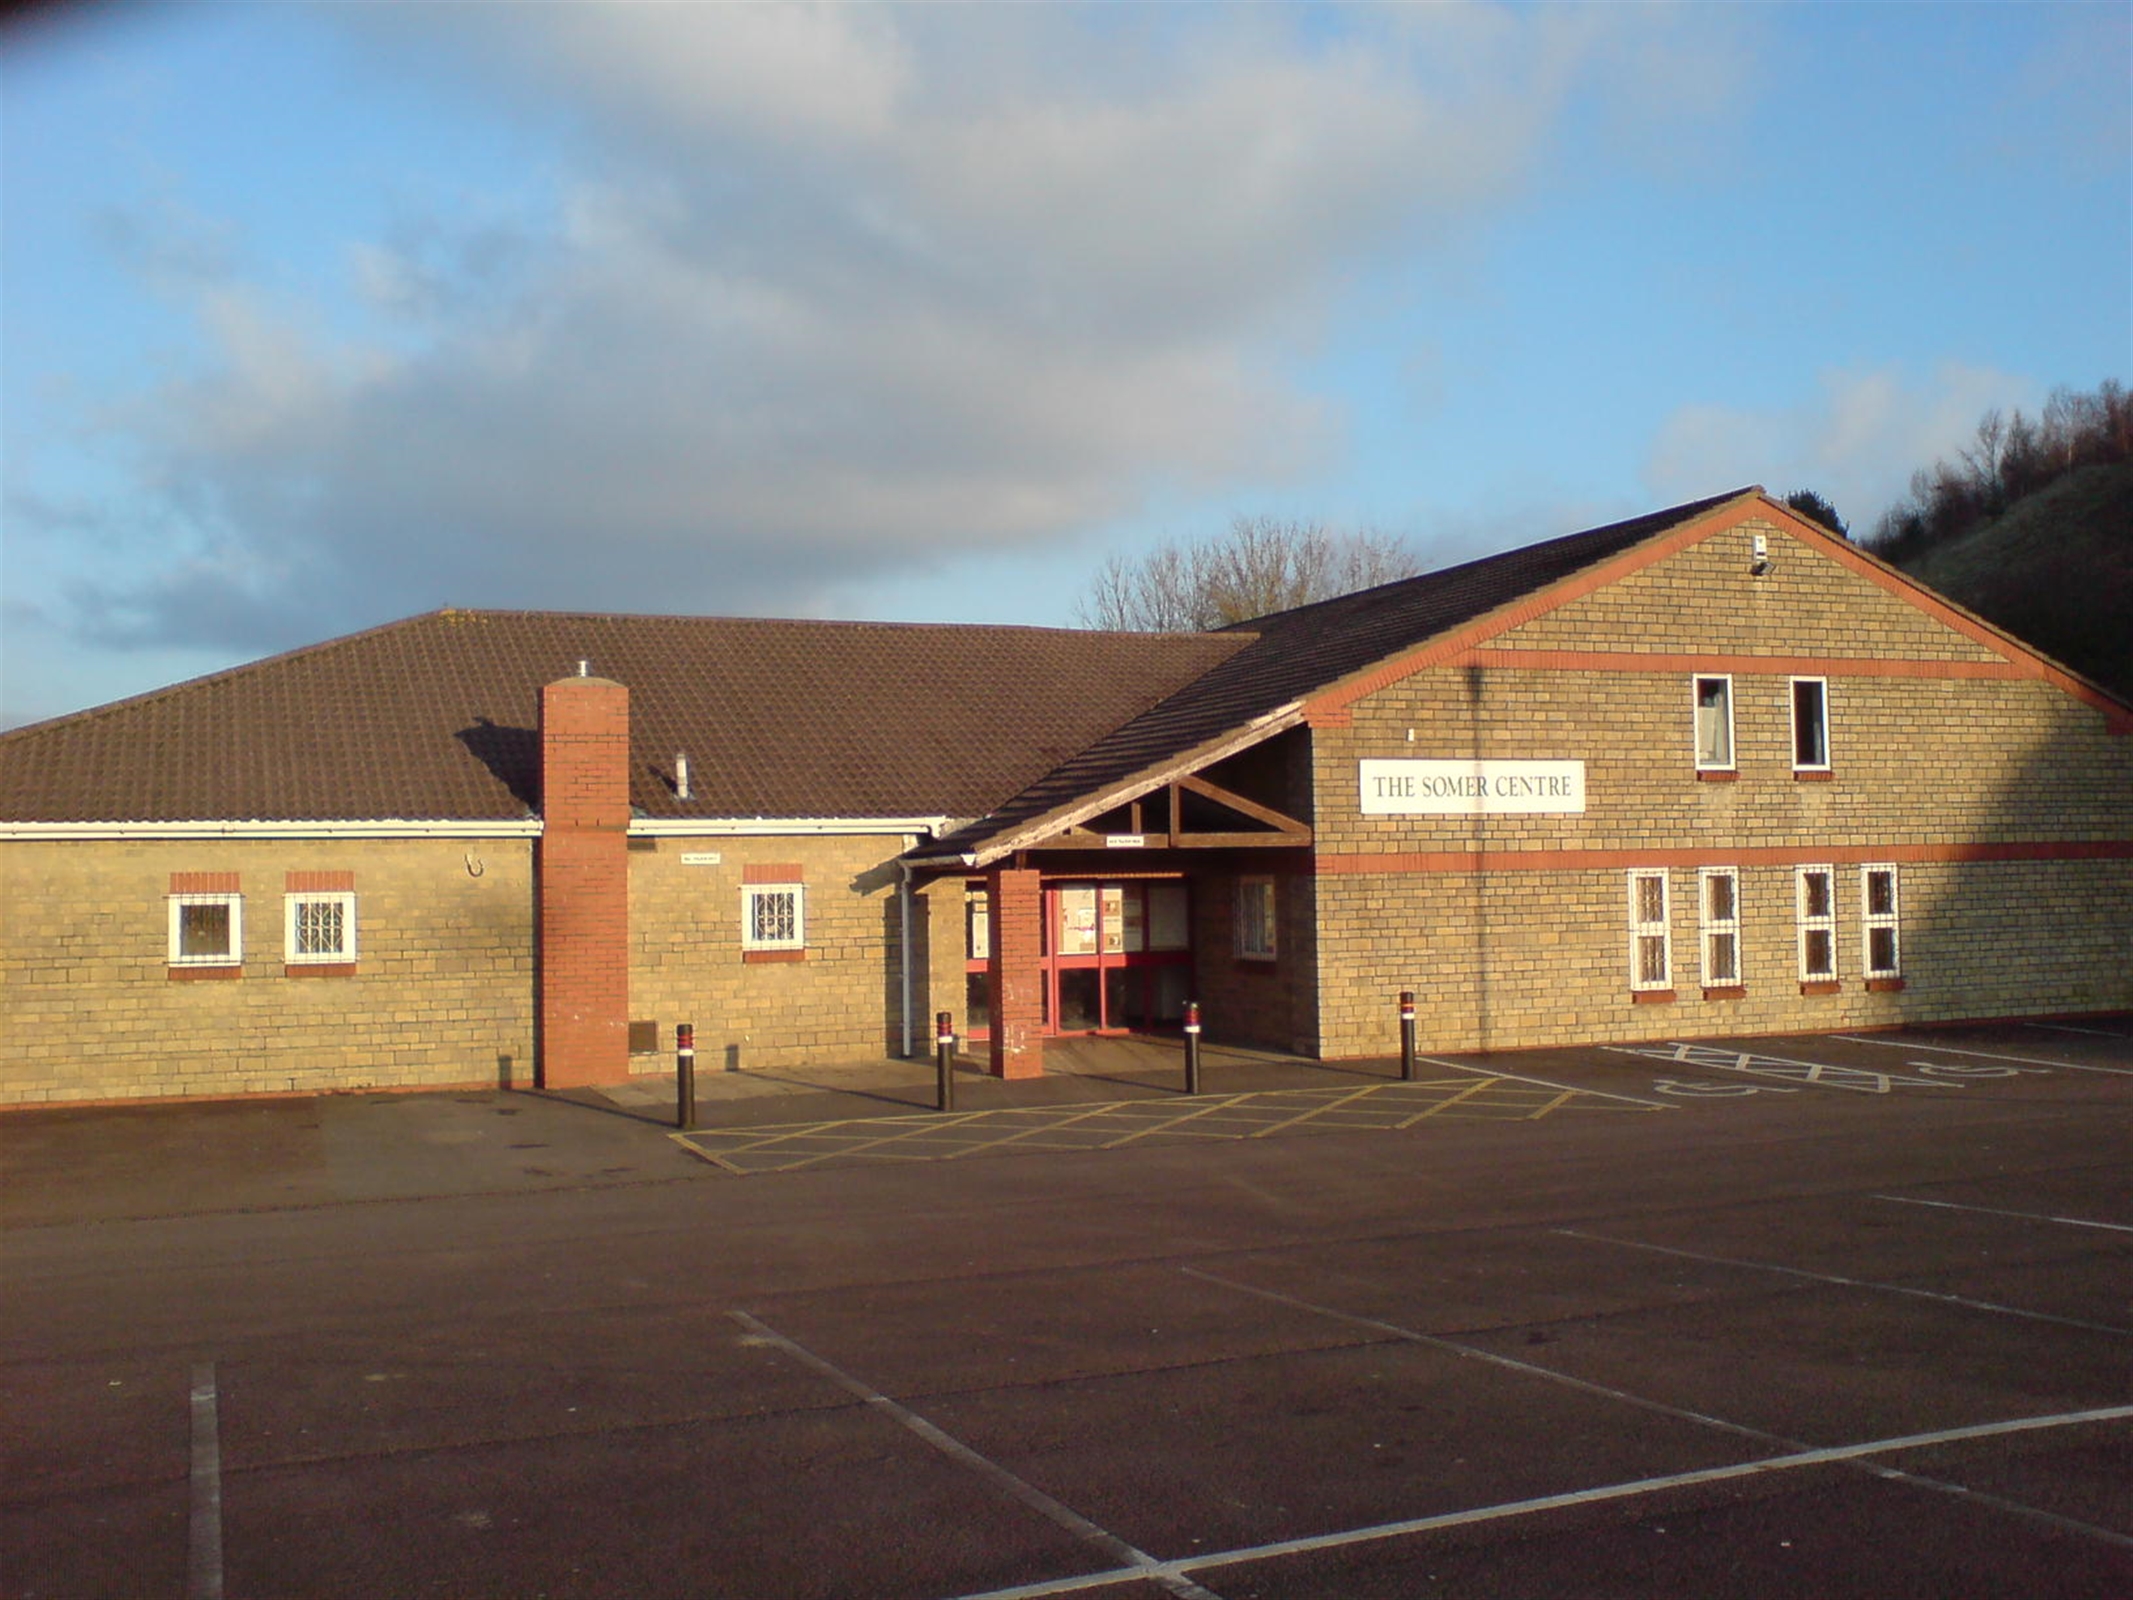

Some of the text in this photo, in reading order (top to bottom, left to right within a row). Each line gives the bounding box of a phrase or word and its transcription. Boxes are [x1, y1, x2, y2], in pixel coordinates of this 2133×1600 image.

[1373, 775, 1572, 798] THE SOMER CENTRE
